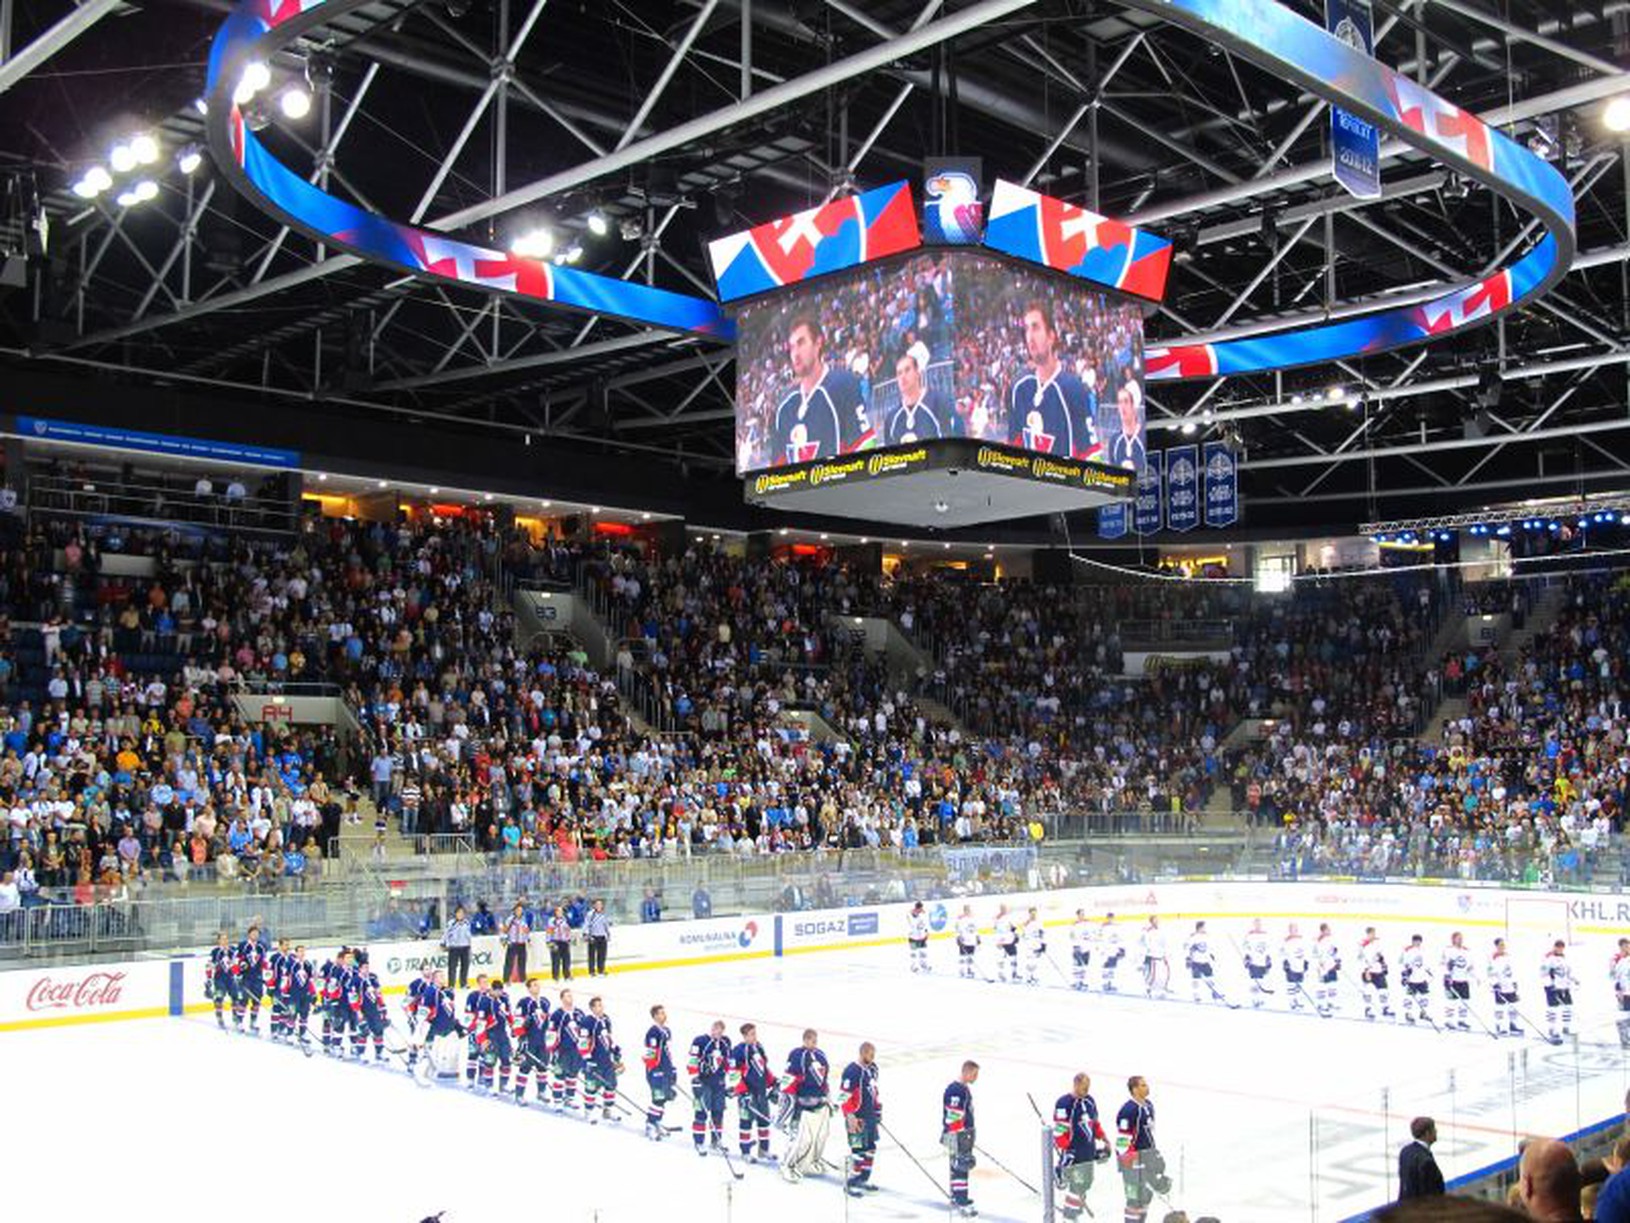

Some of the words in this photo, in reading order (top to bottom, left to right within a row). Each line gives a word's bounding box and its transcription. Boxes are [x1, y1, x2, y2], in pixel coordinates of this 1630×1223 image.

[262, 705, 292, 722] A4
[794, 920, 846, 936] SOGAZ
[404, 951, 493, 972] TRANSROL
[26, 972, 128, 1011] Coca-Cola
